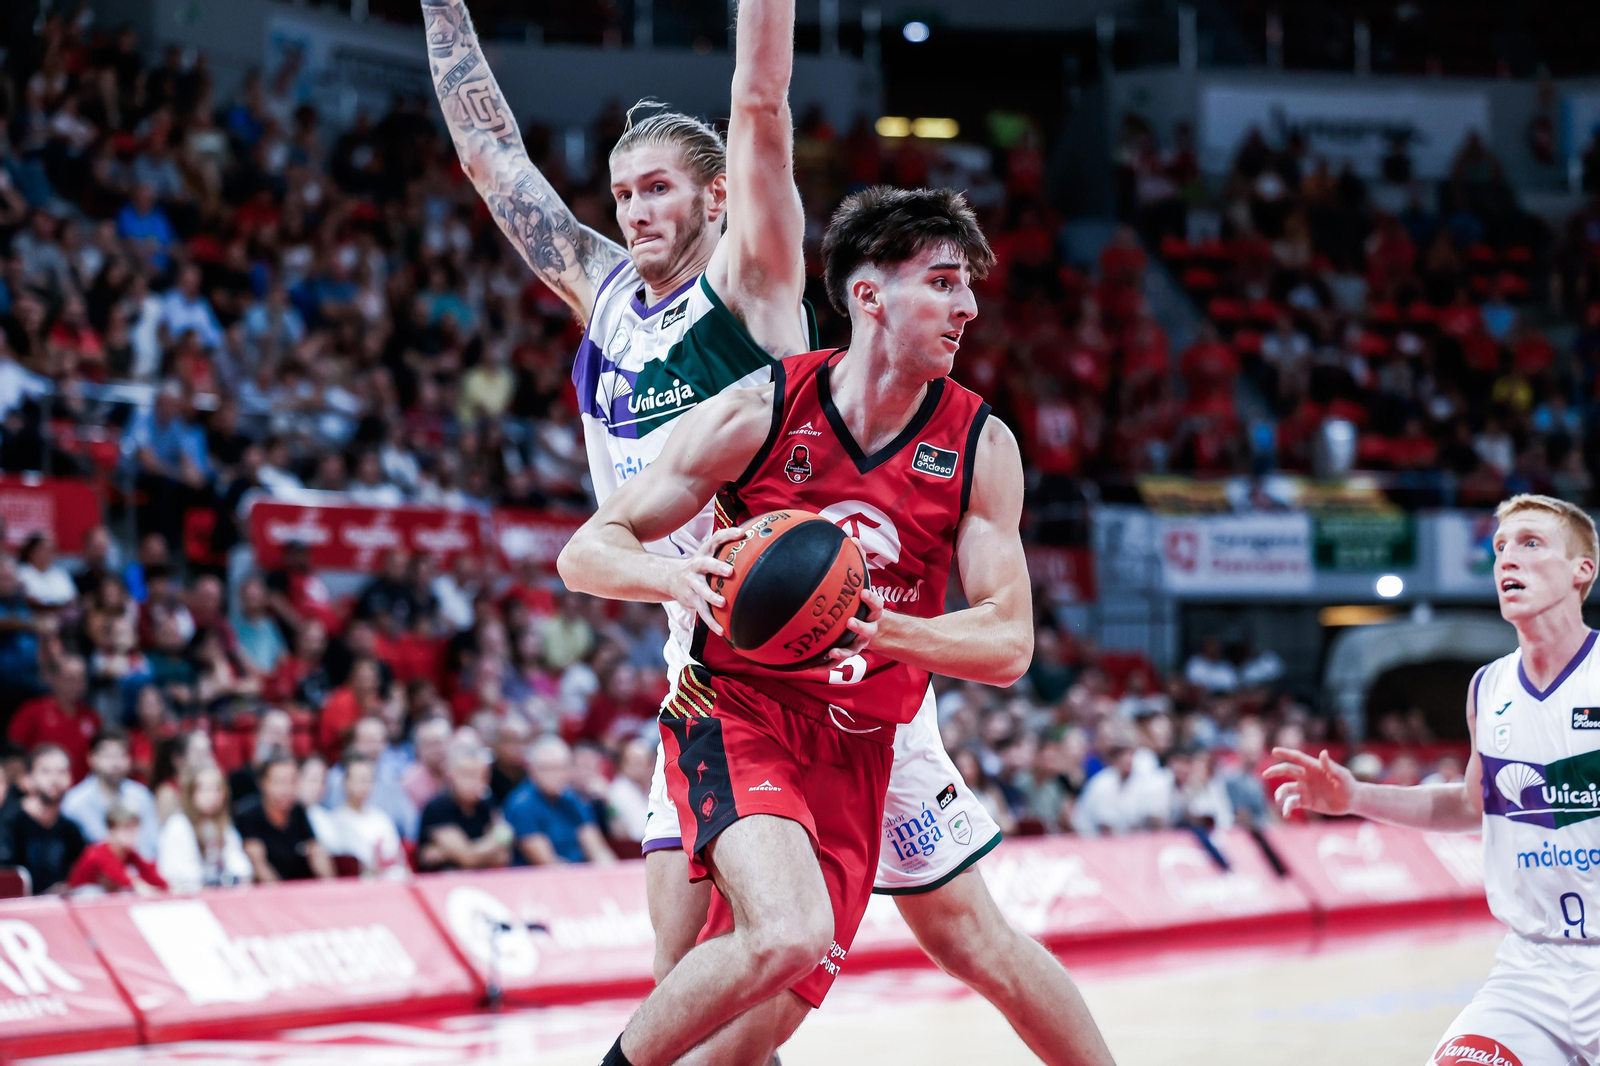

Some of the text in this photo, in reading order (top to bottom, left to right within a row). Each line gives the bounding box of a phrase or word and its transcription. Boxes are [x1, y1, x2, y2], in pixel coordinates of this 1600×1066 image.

[627, 378, 695, 413] Unicaja
[916, 460, 952, 474] endesa
[919, 451, 935, 462] liga
[783, 565, 863, 658] SPALDING
[940, 791, 953, 808] acb
[1541, 782, 1600, 808] Uicaj
[890, 826, 944, 861] laga
[1559, 892, 1587, 939] 9
